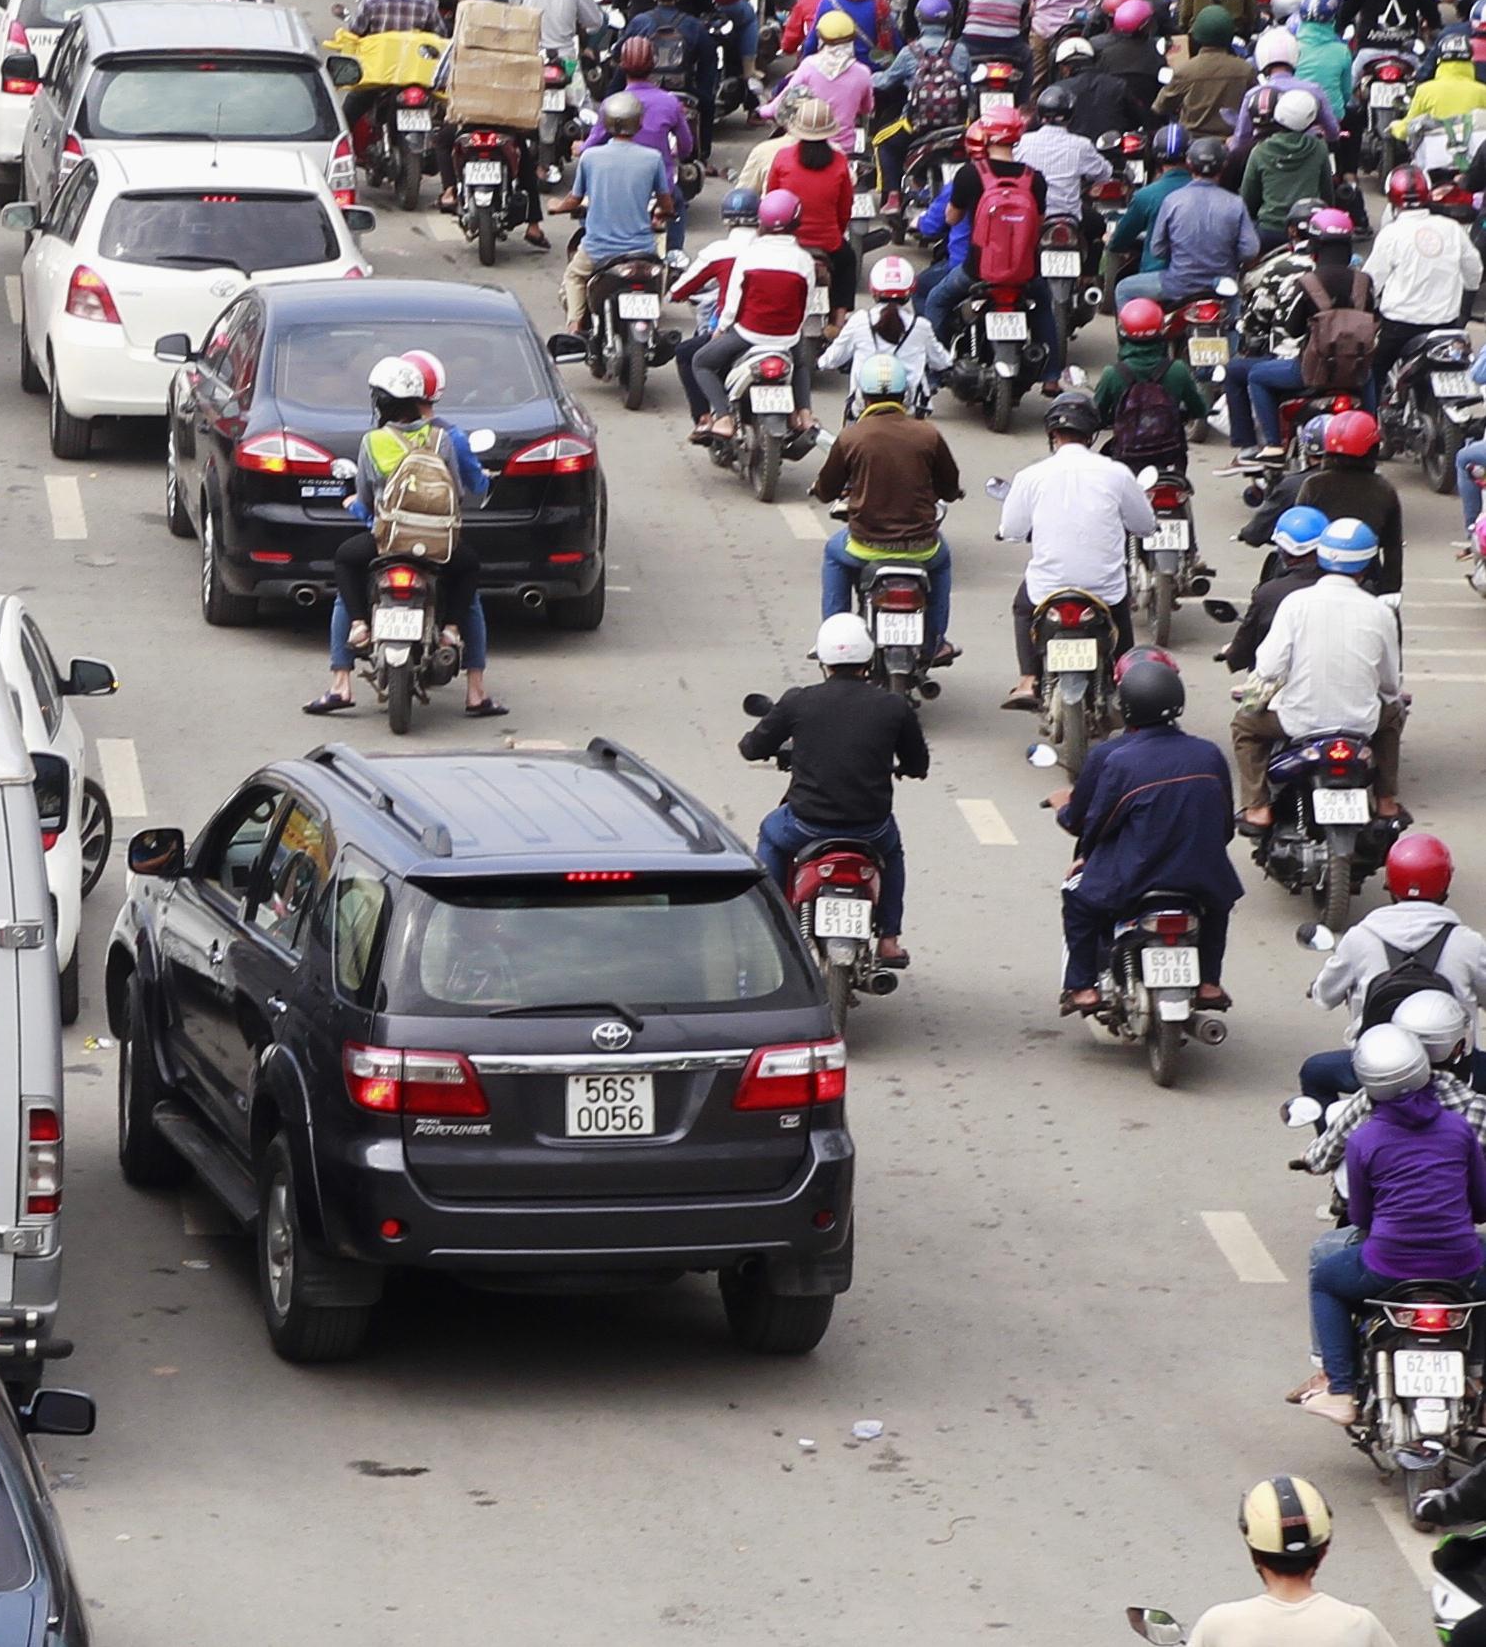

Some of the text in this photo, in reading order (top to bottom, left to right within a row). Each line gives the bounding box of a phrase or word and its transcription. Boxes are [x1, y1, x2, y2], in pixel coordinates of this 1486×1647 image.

[585, 1076, 635, 1104] 56S
[412, 1123, 493, 1136] FORTUNER
[577, 1105, 644, 1133] 0056
